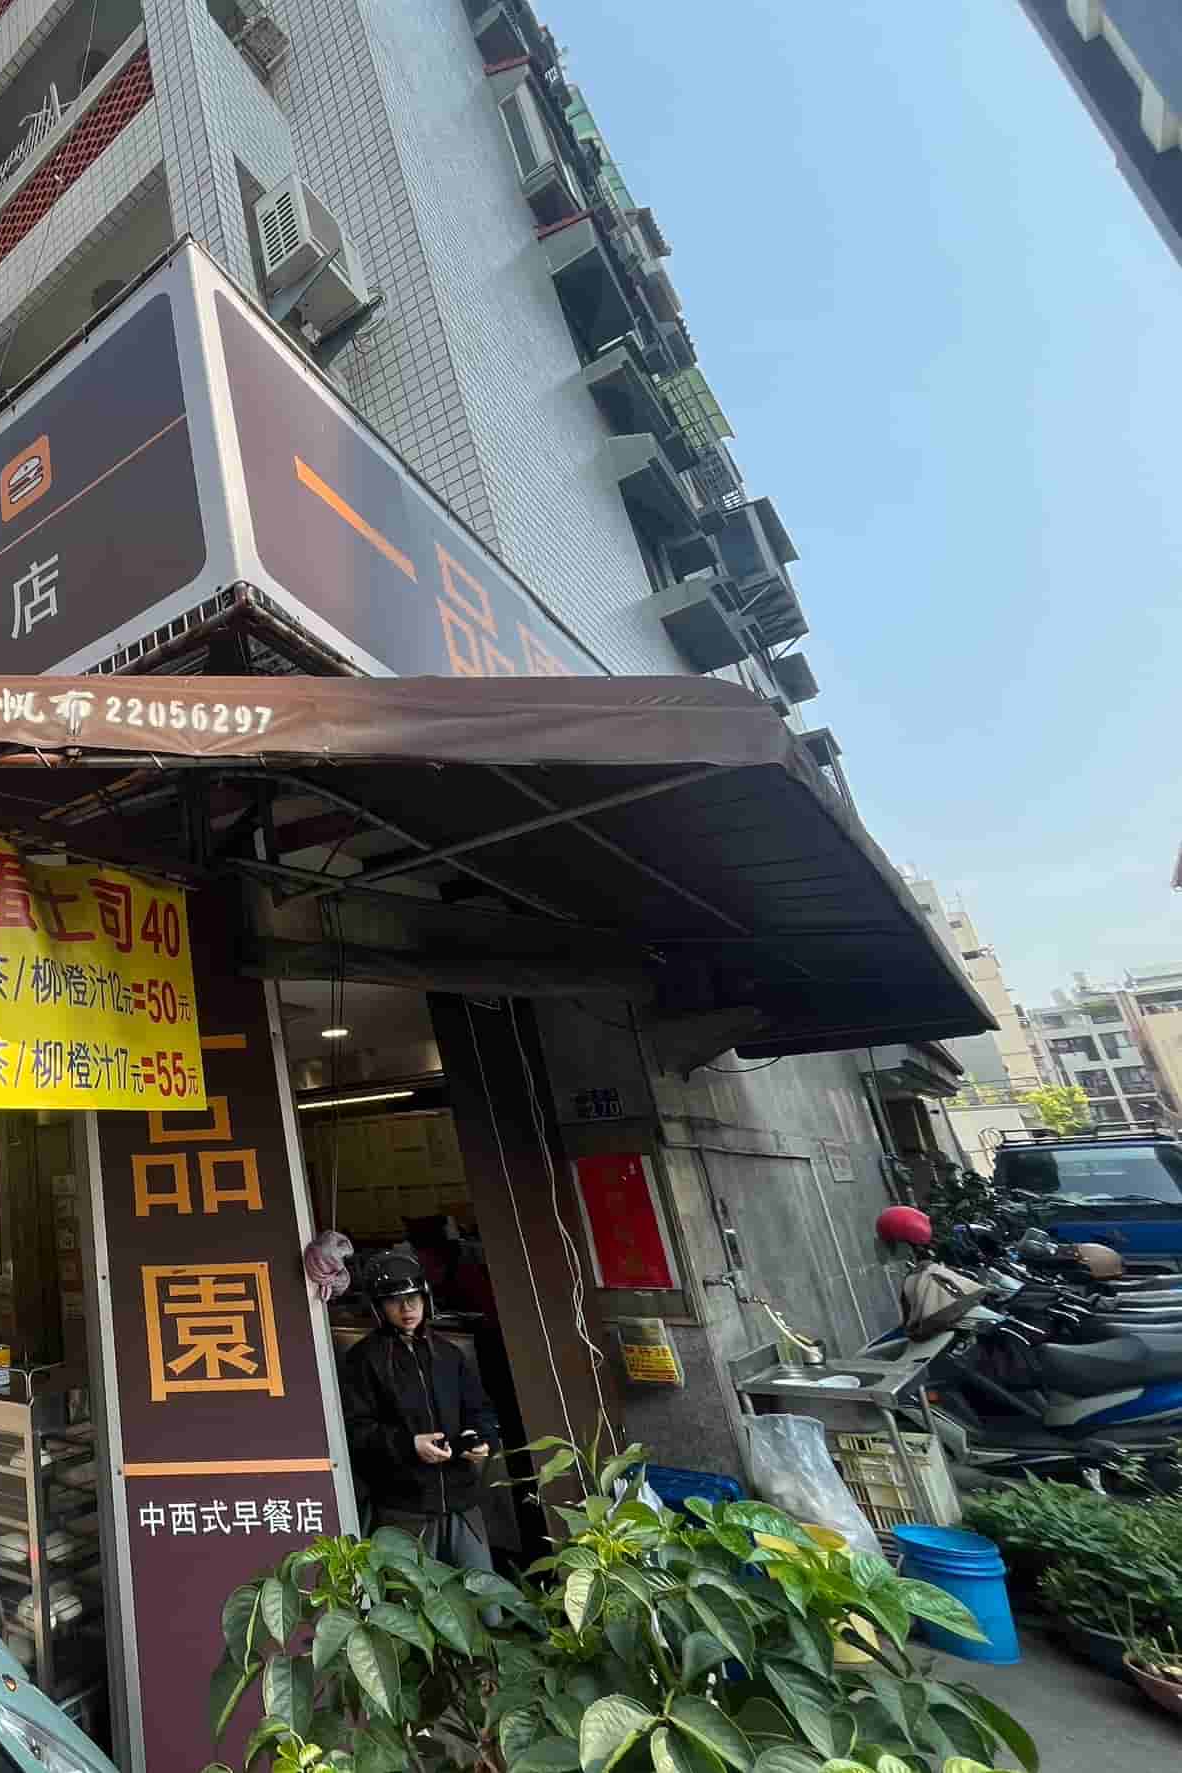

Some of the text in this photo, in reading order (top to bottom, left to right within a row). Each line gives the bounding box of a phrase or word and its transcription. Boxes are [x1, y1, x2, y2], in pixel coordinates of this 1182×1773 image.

[105, 696, 273, 735] 22056297
[138, 1498, 324, 1537] 中西式早餐店
